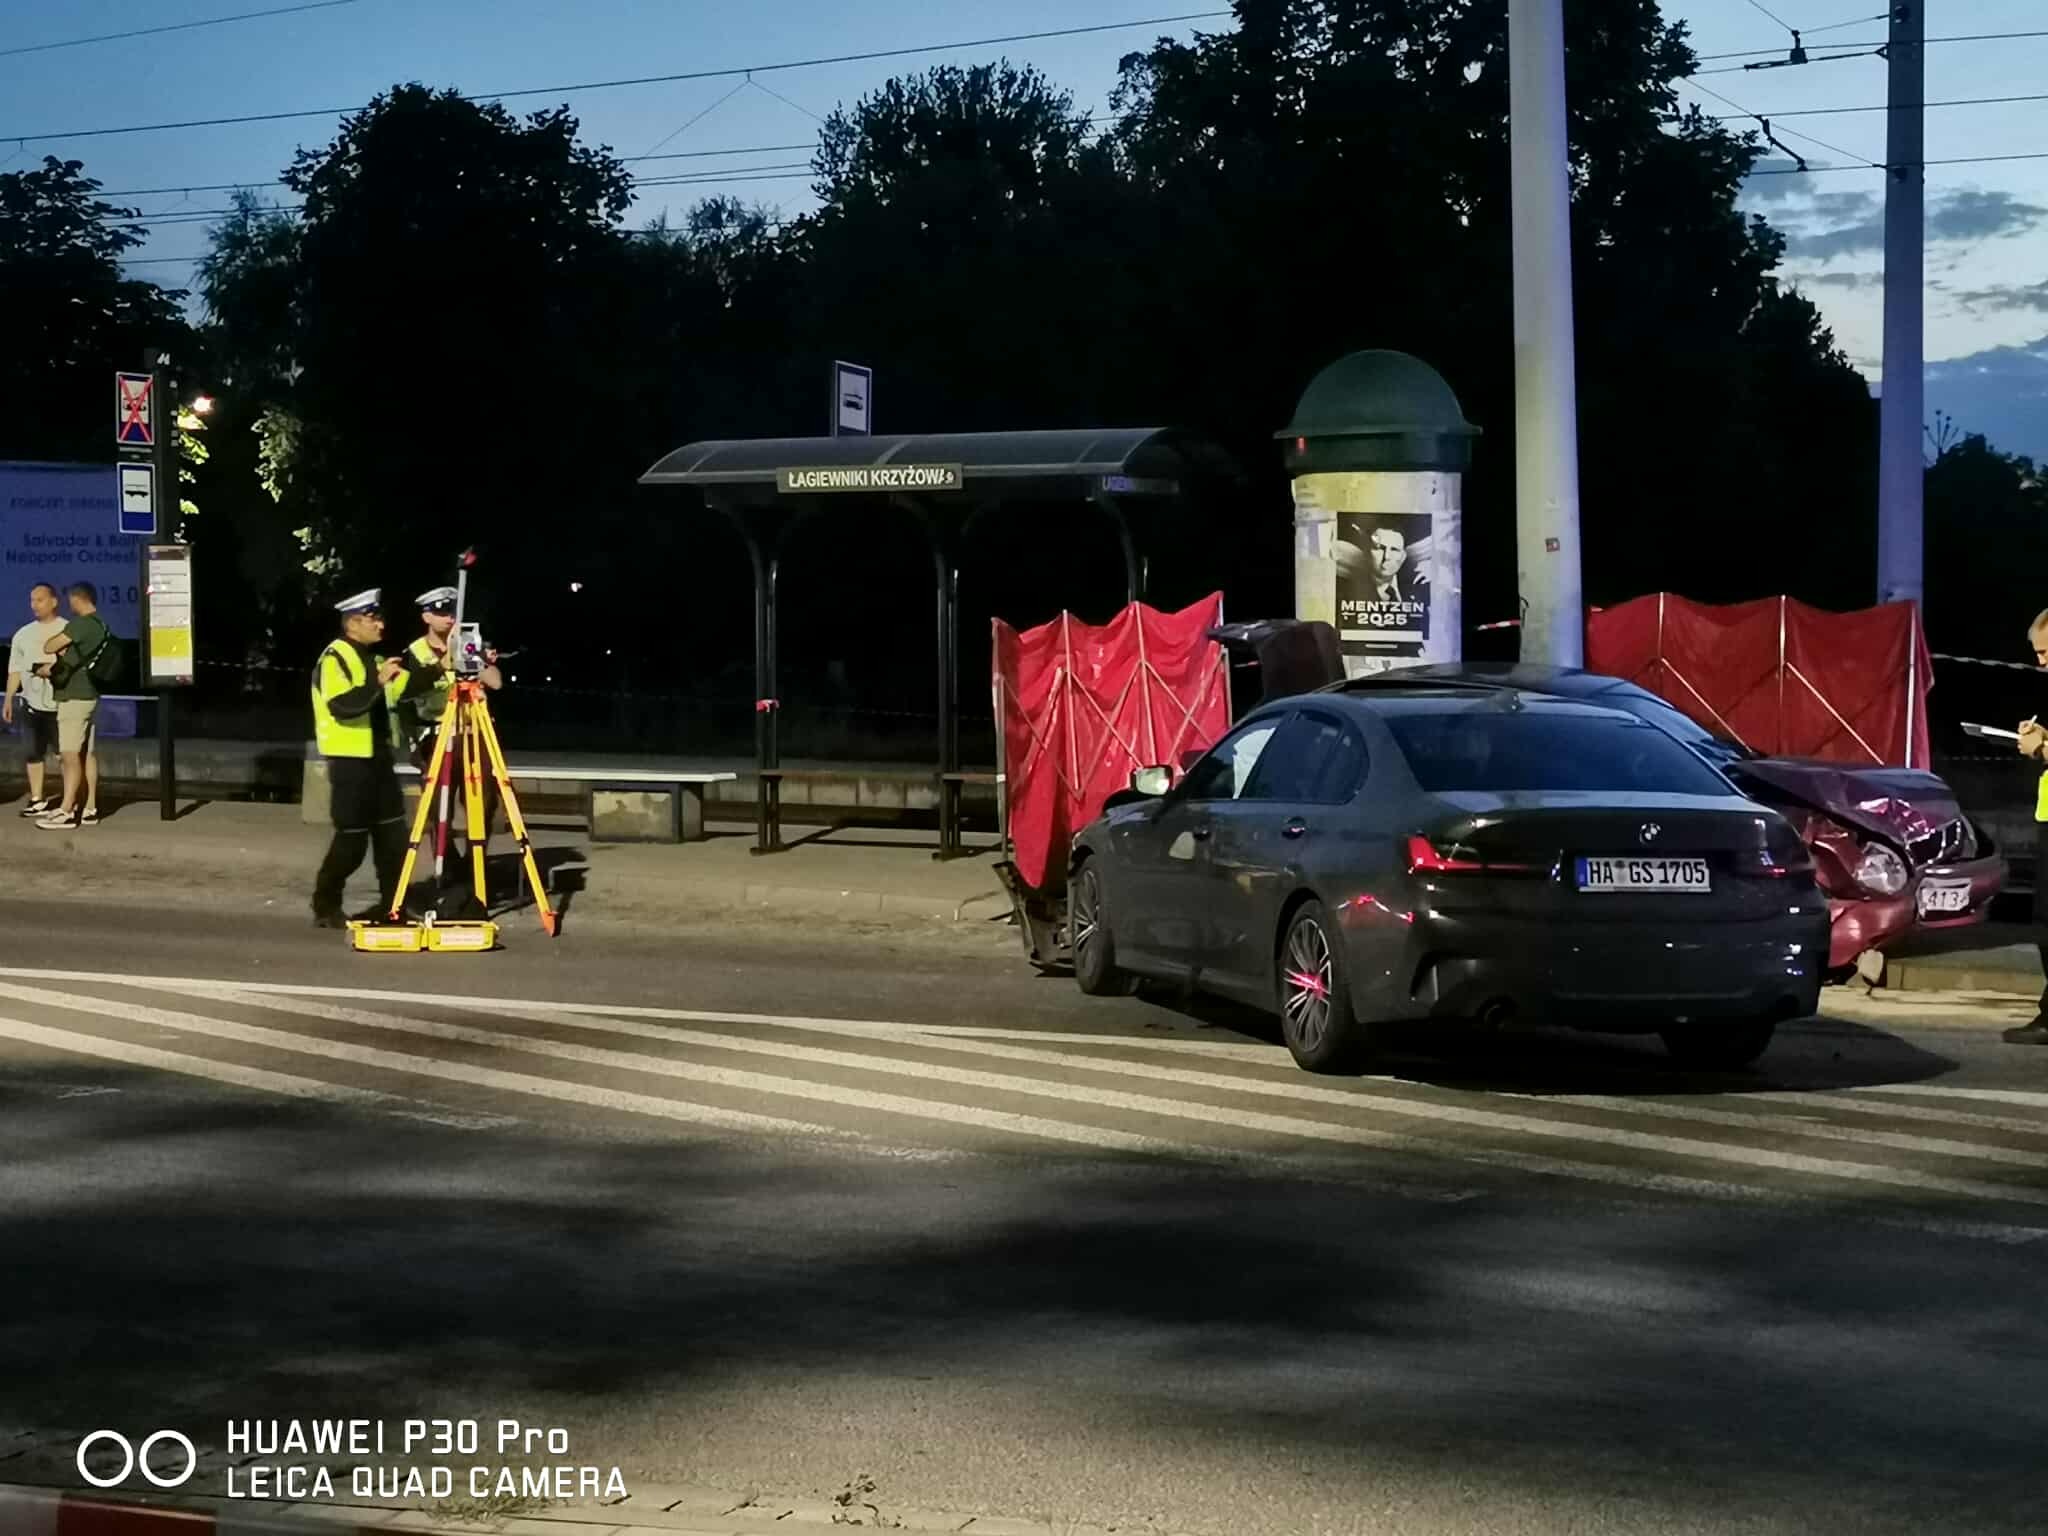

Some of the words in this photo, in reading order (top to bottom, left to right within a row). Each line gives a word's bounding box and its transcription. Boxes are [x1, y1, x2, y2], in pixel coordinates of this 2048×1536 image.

[788, 469, 868, 487] ŁAGIEWNIKI
[1341, 600, 1425, 613] MENTZEN
[1589, 860, 1614, 884] HA
